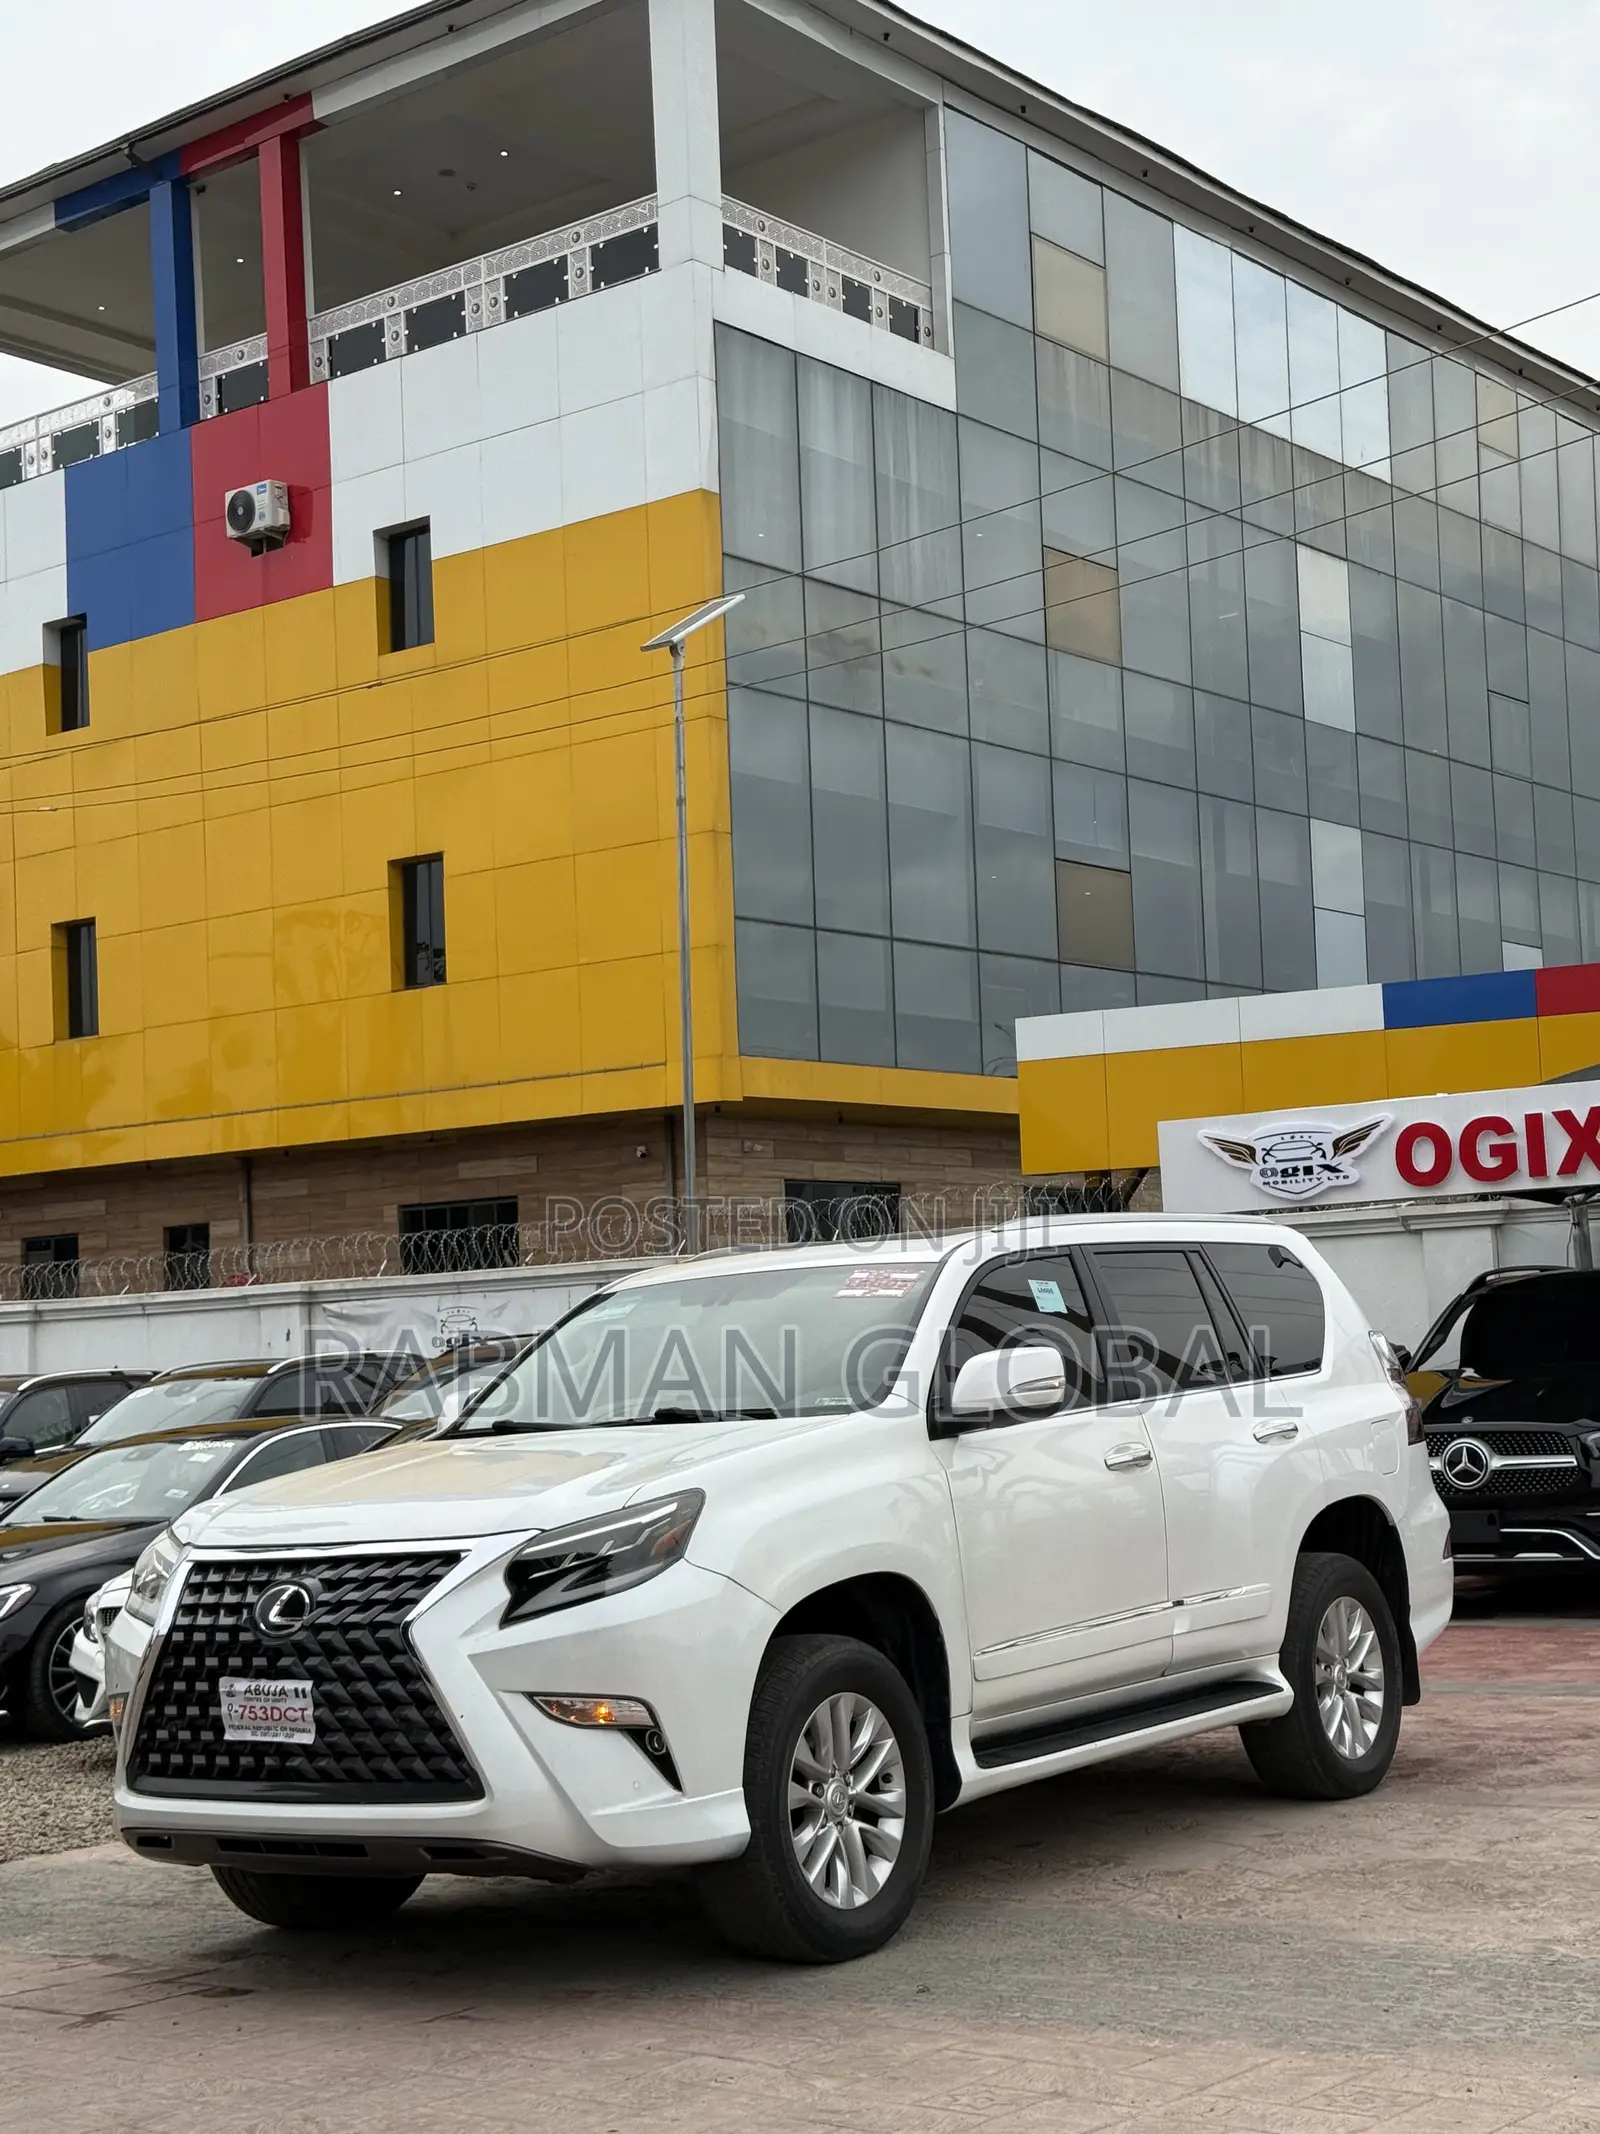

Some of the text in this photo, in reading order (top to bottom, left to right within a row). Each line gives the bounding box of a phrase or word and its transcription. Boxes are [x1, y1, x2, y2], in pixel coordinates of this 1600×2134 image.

[1395, 1106, 1600, 1188] OGIX
[1262, 1176, 1323, 1186] MOBILITY
[243, 1684, 289, 1698] ABUJA
